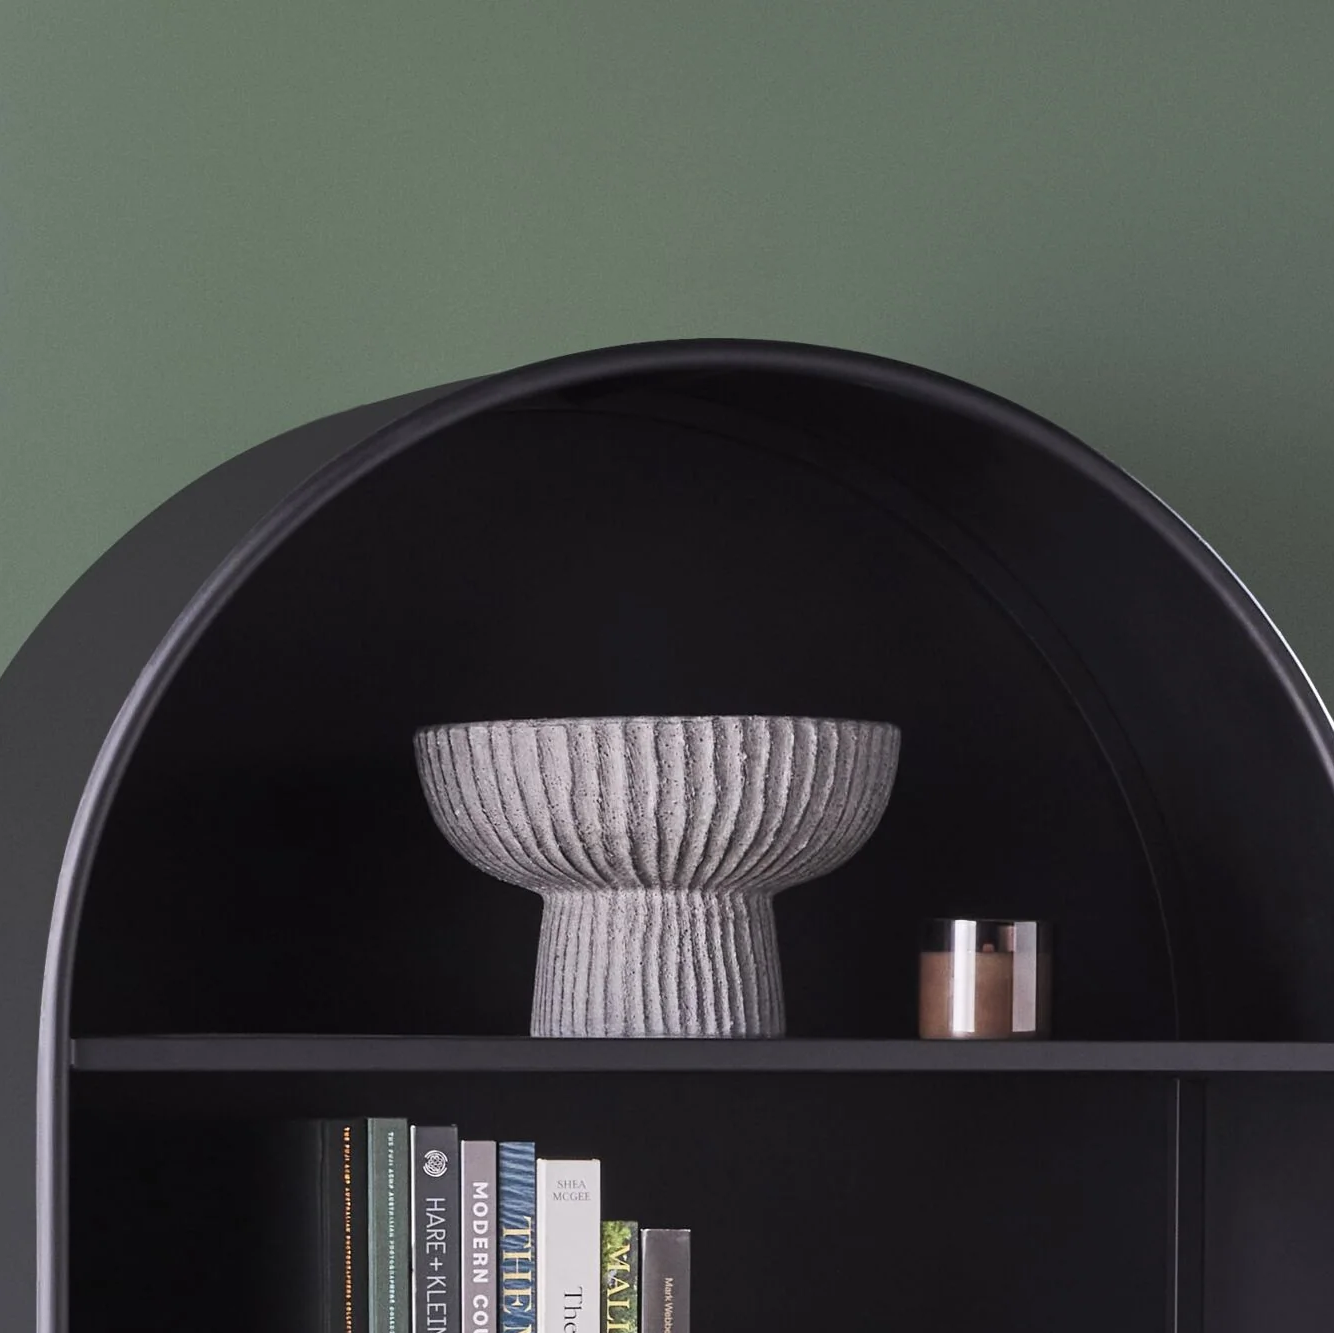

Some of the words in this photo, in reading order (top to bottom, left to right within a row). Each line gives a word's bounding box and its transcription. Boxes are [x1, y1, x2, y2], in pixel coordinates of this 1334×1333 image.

[552, 1191, 592, 1201] MCGEE
[556, 1179, 587, 1190] SHEA
[425, 1198, 446, 1254] HARE
[472, 1181, 489, 1284] MODERN
[502, 1215, 533, 1314] THE
[563, 1286, 583, 1333] The
[663, 1277, 673, 1301] Mark
